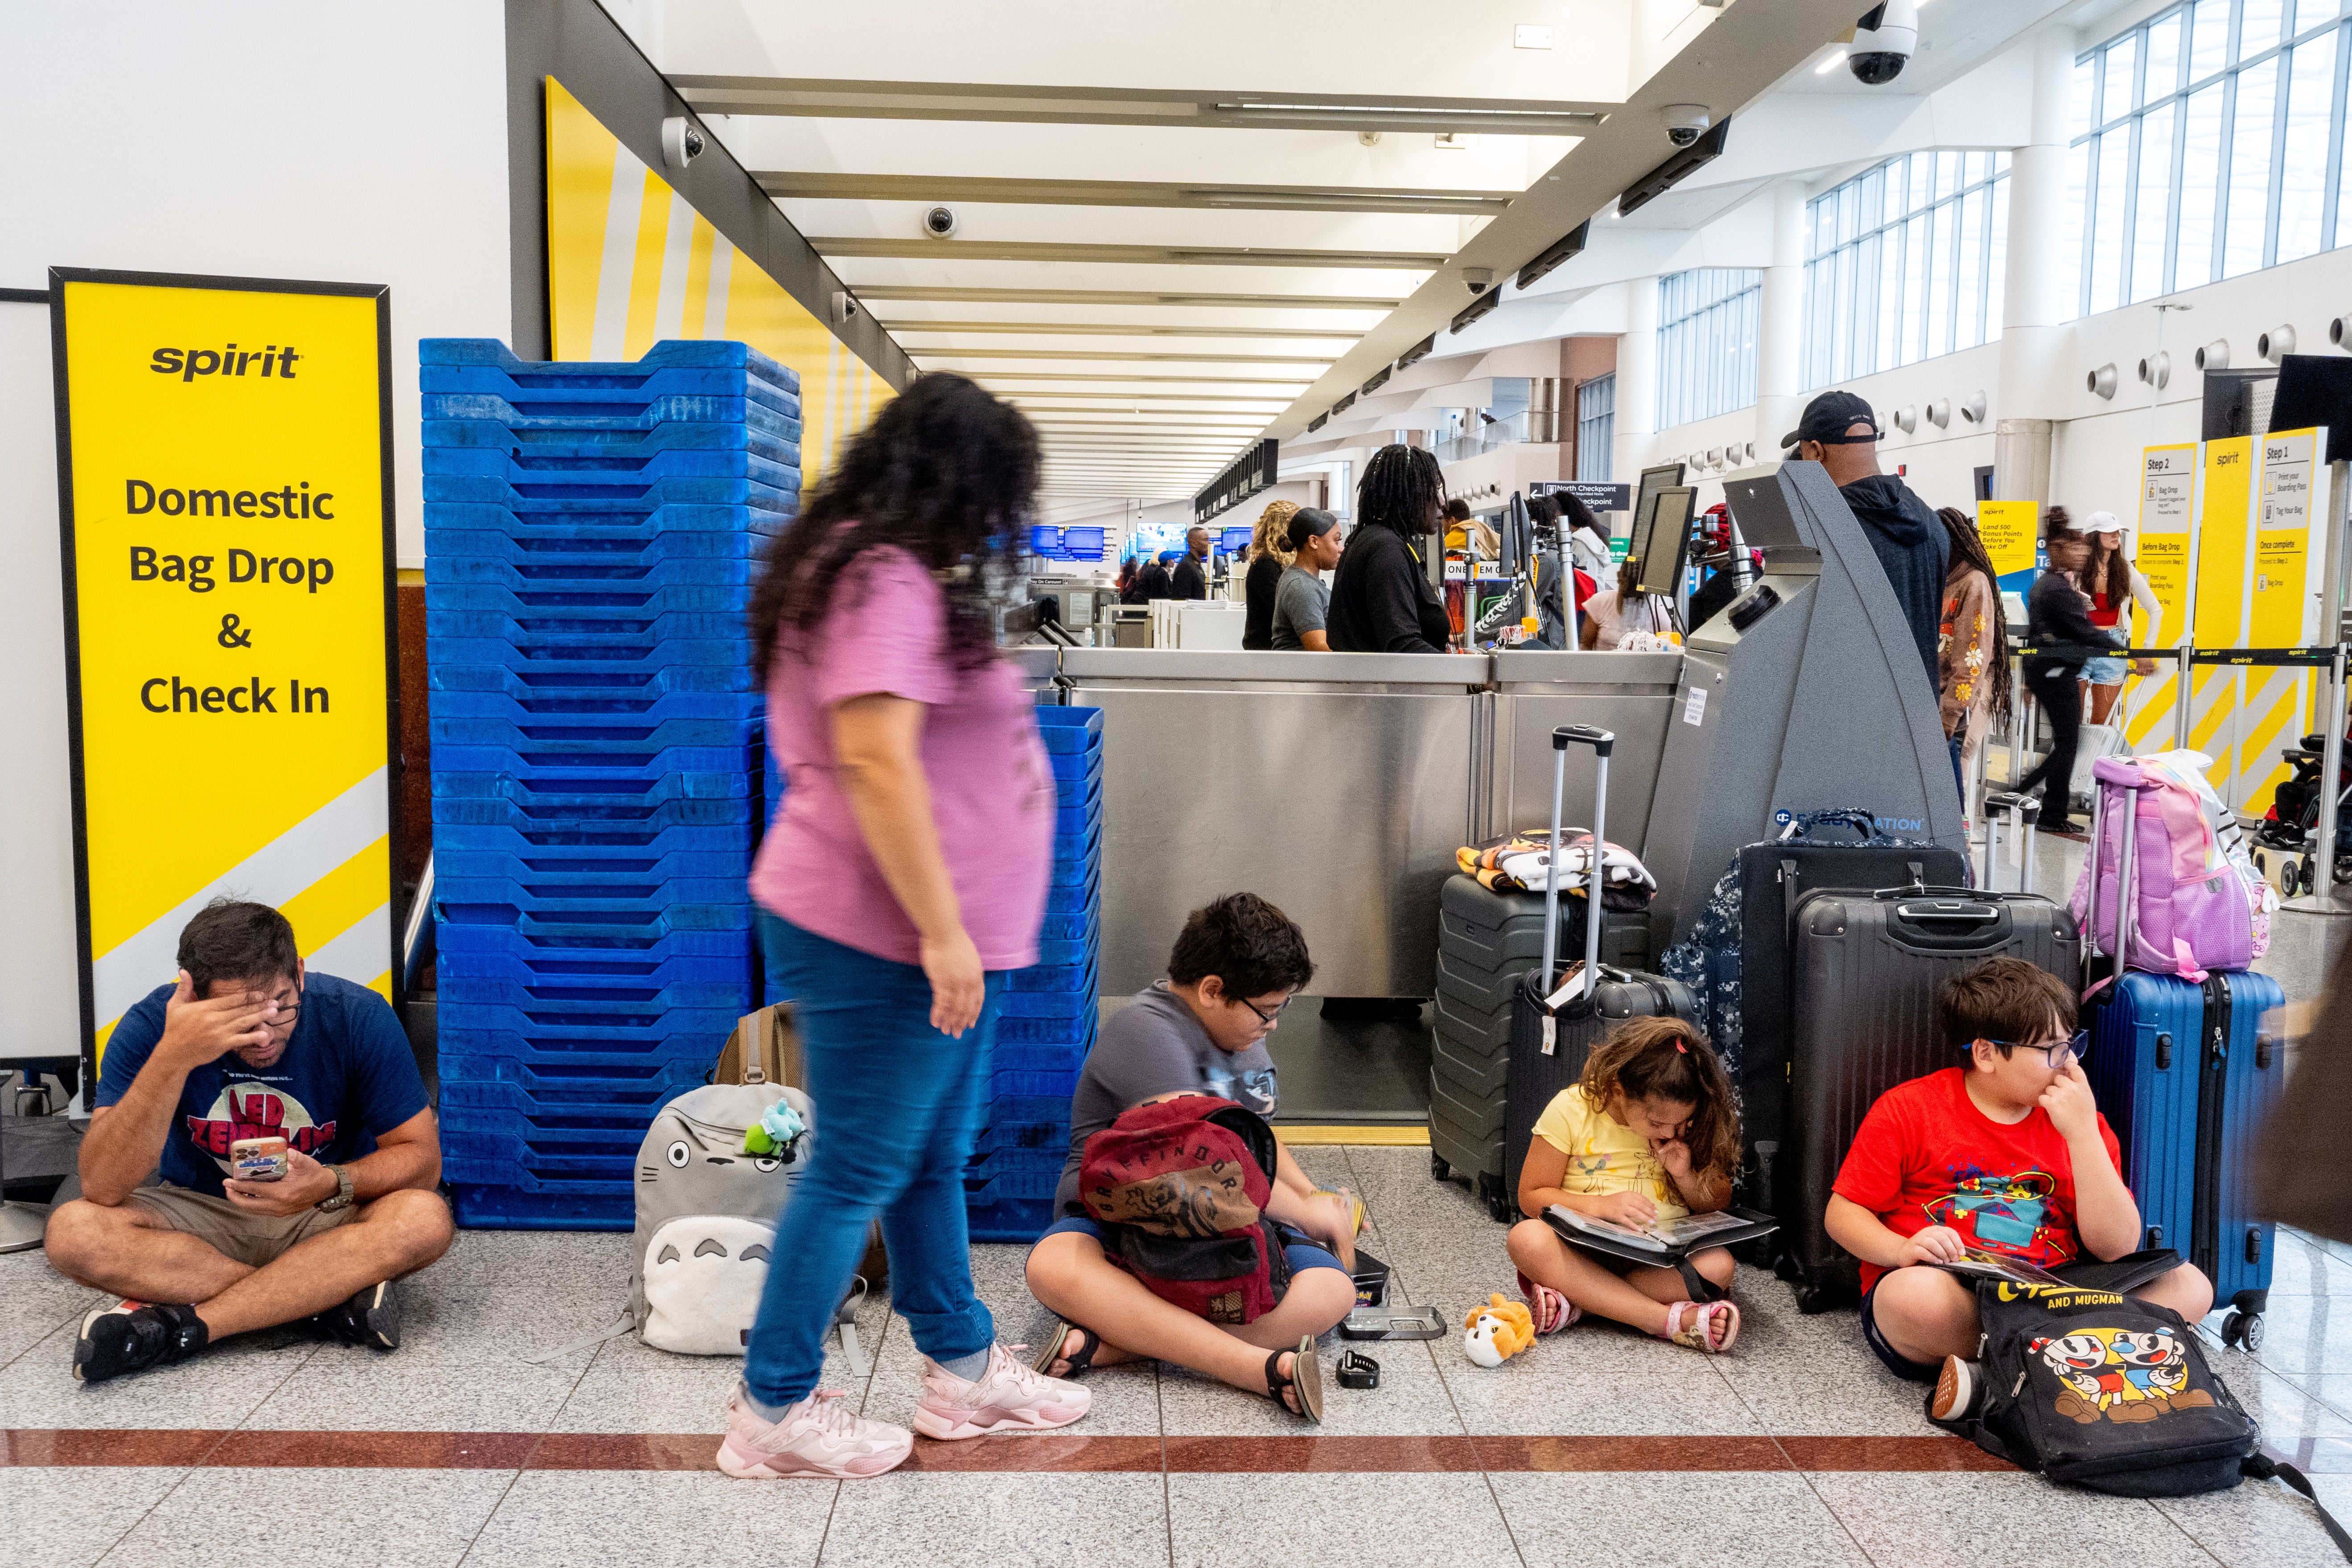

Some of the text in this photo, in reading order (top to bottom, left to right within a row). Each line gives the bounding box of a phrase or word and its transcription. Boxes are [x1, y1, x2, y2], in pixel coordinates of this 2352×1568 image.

[149, 344, 300, 382] spirit
[2217, 452, 2239, 467] spirit
[2267, 446, 2288, 461] Step 1
[2148, 458, 2169, 472] Step 2
[2290, 473, 2299, 481] your
[2278, 483, 2296, 492] Boarding
[126, 479, 334, 520] Domestic
[2294, 506, 2303, 515] Bag
[2158, 543, 2167, 552] Bag
[2168, 543, 2180, 551] Drop
[2273, 540, 2294, 550] complete
[130, 547, 334, 593] Bag Drop
[217, 613, 252, 648] &
[141, 676, 329, 713] Check In
[229, 1089, 284, 1126] LED
[1096, 1145, 1237, 1212] GRYFFINDOR
[2048, 1295, 2123, 1309] AND MUGMAN
